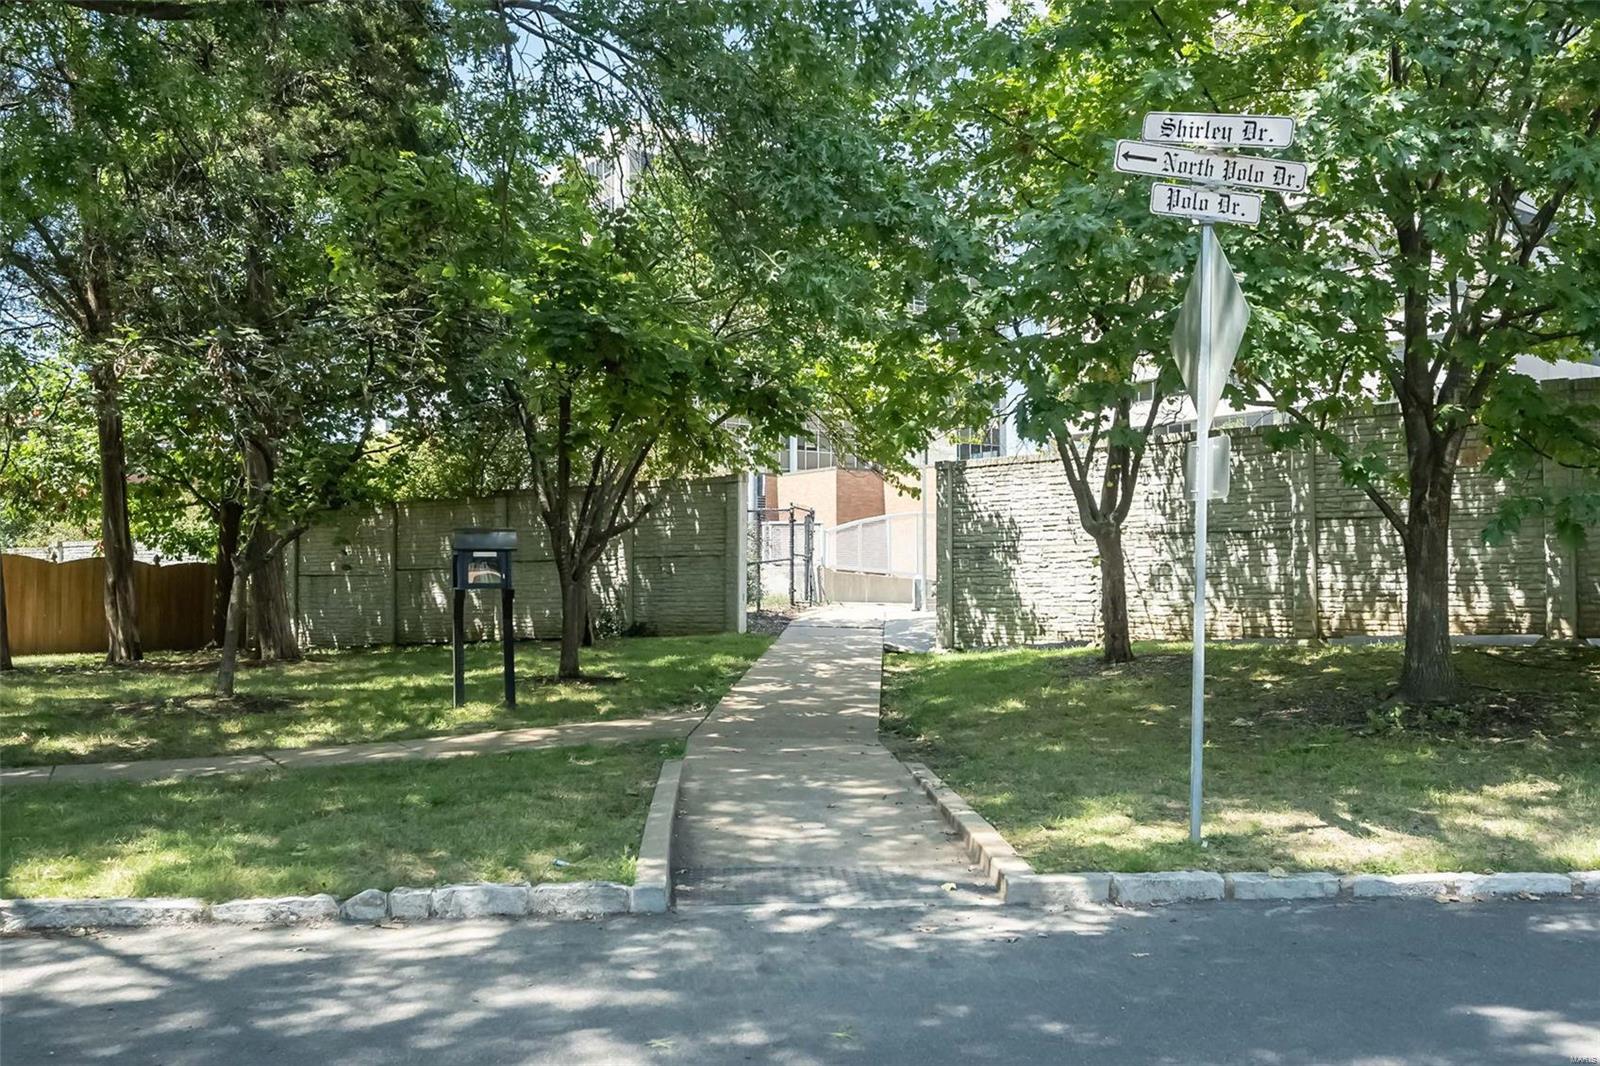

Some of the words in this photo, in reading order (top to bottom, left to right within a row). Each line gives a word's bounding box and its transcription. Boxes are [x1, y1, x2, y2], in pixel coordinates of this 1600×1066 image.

[1160, 117, 1233, 143] Shirley
[1242, 120, 1274, 143] Dr.
[1161, 151, 1214, 178] North
[1223, 158, 1264, 183] Polo
[1272, 165, 1300, 189] Dr.
[1166, 187, 1209, 212] Polo
[1217, 193, 1246, 217] Dr.
